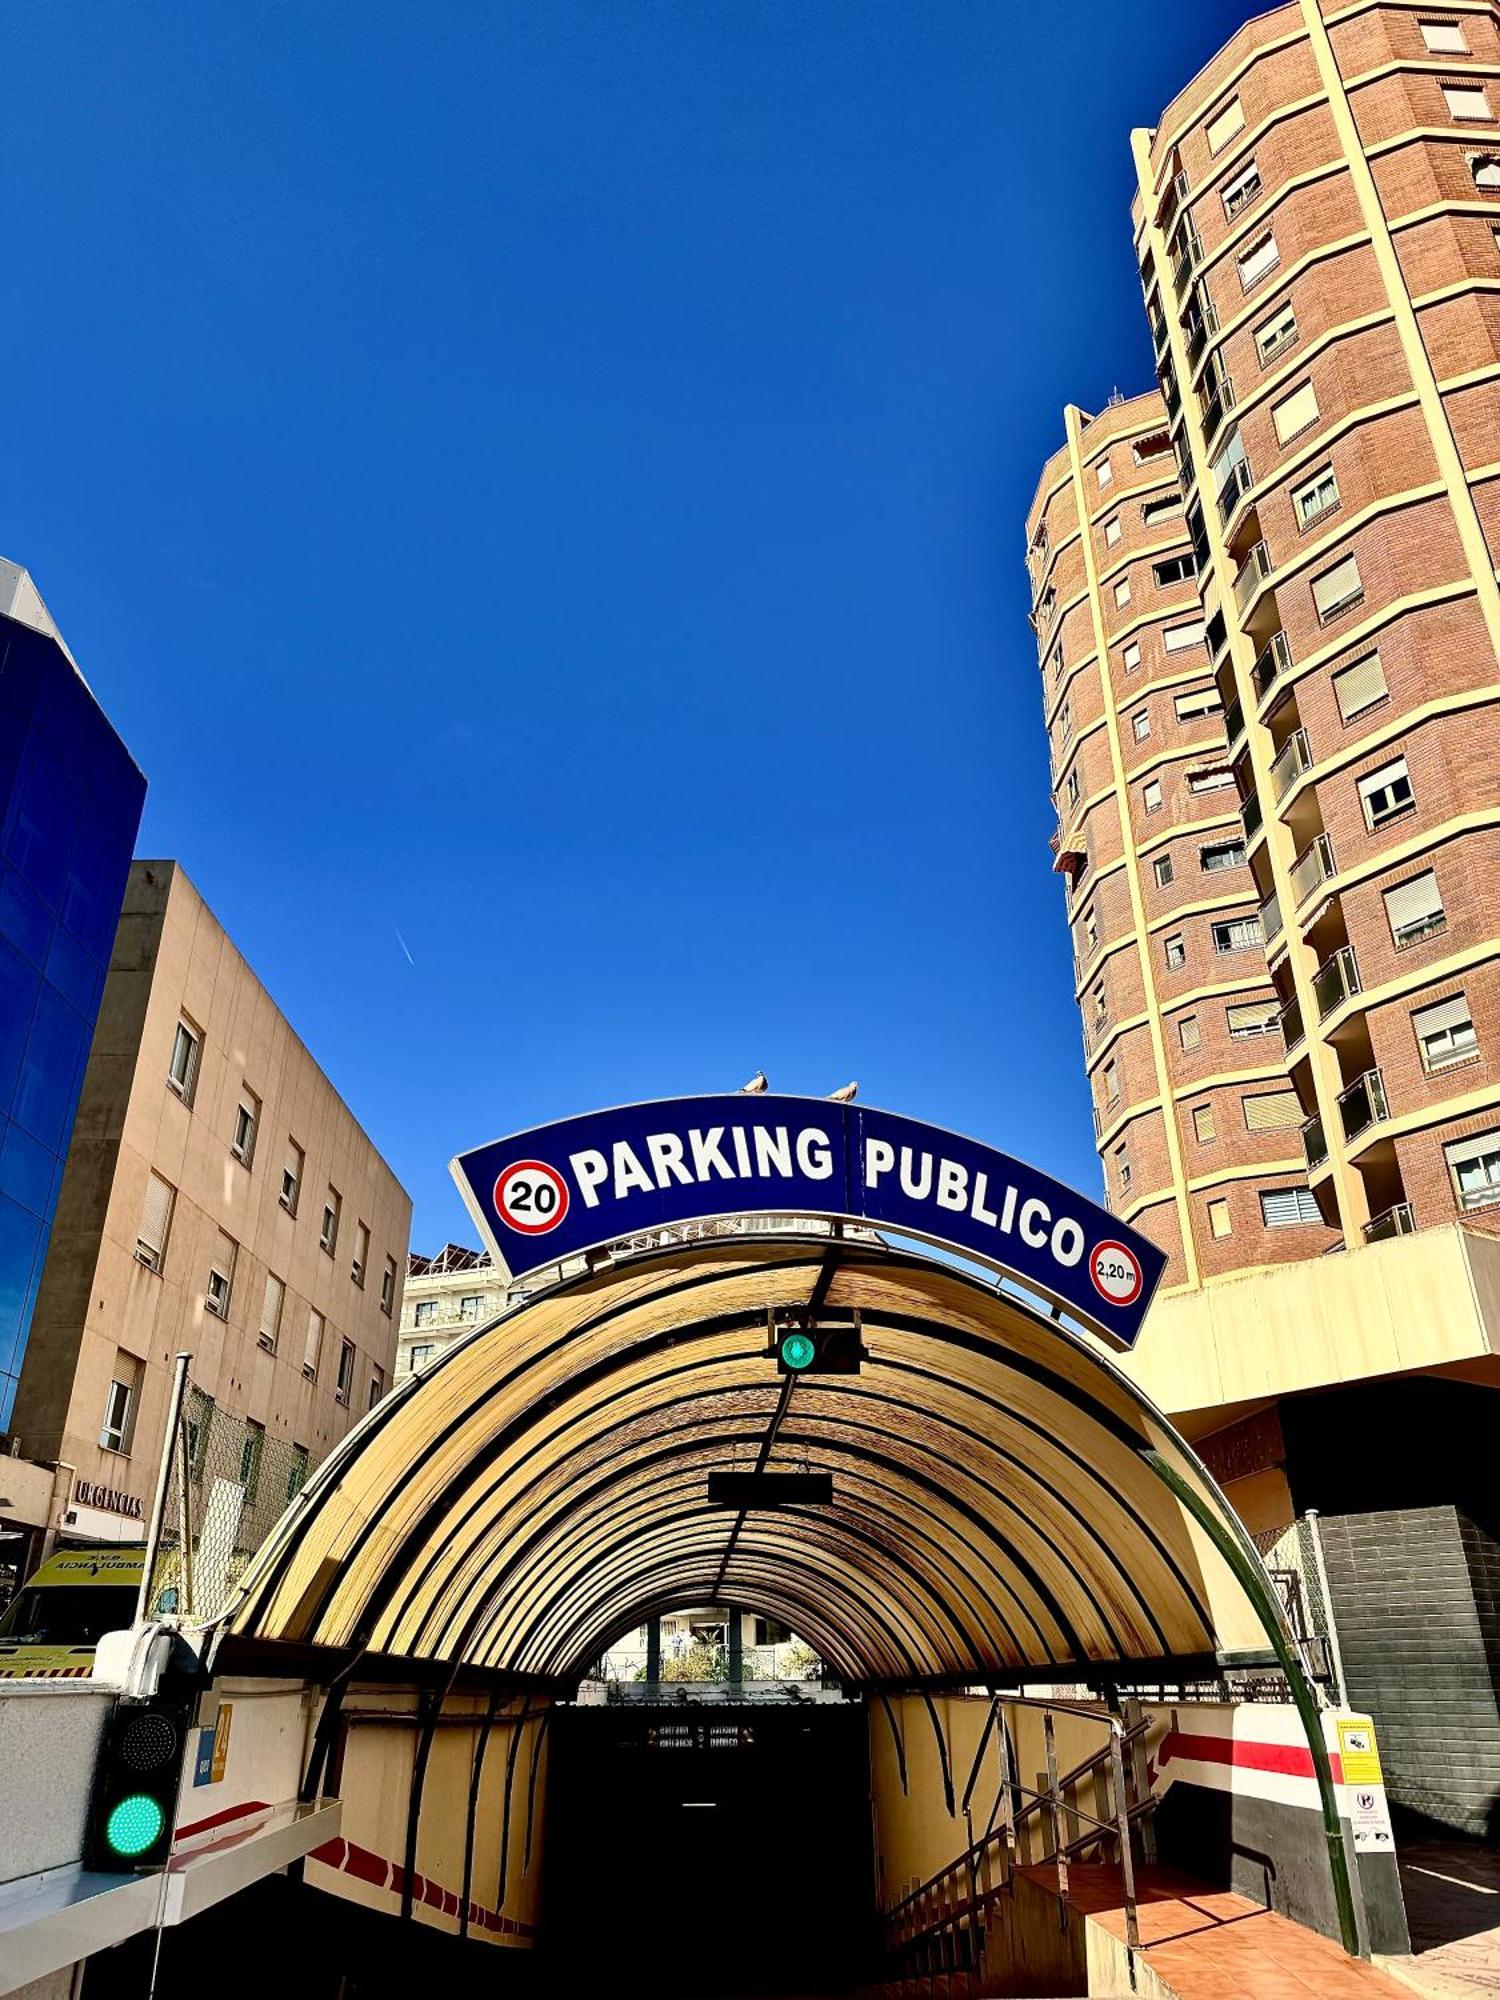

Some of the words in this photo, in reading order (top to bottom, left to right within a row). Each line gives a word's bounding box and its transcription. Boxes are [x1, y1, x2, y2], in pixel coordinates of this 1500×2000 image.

[509, 1180, 557, 1214] 20
[569, 1126, 834, 1208] PARKING
[866, 1138, 1085, 1267] PUBLICO
[1097, 1261, 1125, 1280] 2,20
[1126, 1271, 1136, 1282] m
[77, 1480, 144, 1517] URGENCIAS
[659, 1737, 693, 1748] entrance
